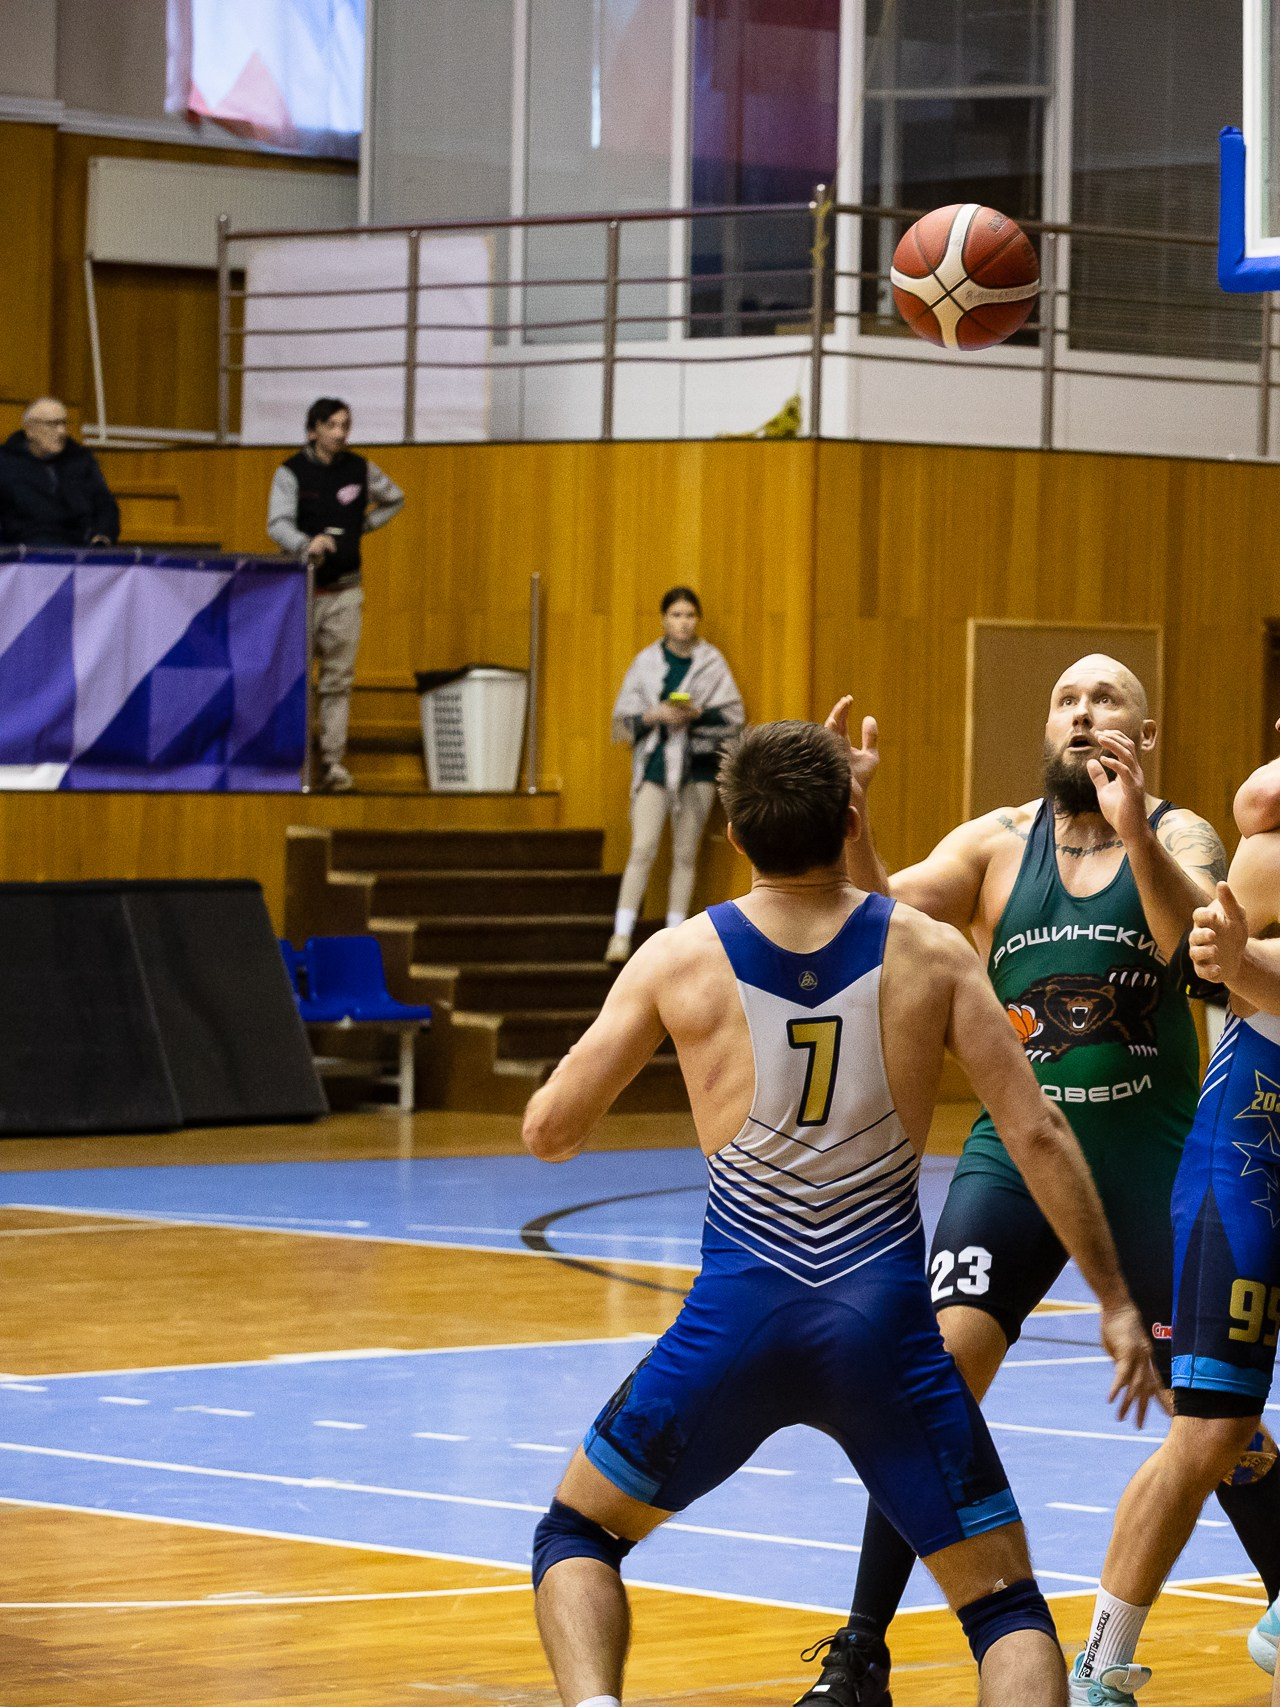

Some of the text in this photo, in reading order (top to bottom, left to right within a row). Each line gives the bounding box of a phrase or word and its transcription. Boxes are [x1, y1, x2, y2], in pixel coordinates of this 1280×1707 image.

[786, 1015, 843, 1127] 7
[1041, 1074, 1152, 1103] ДВЕДИ
[931, 1246, 993, 1303] 23
